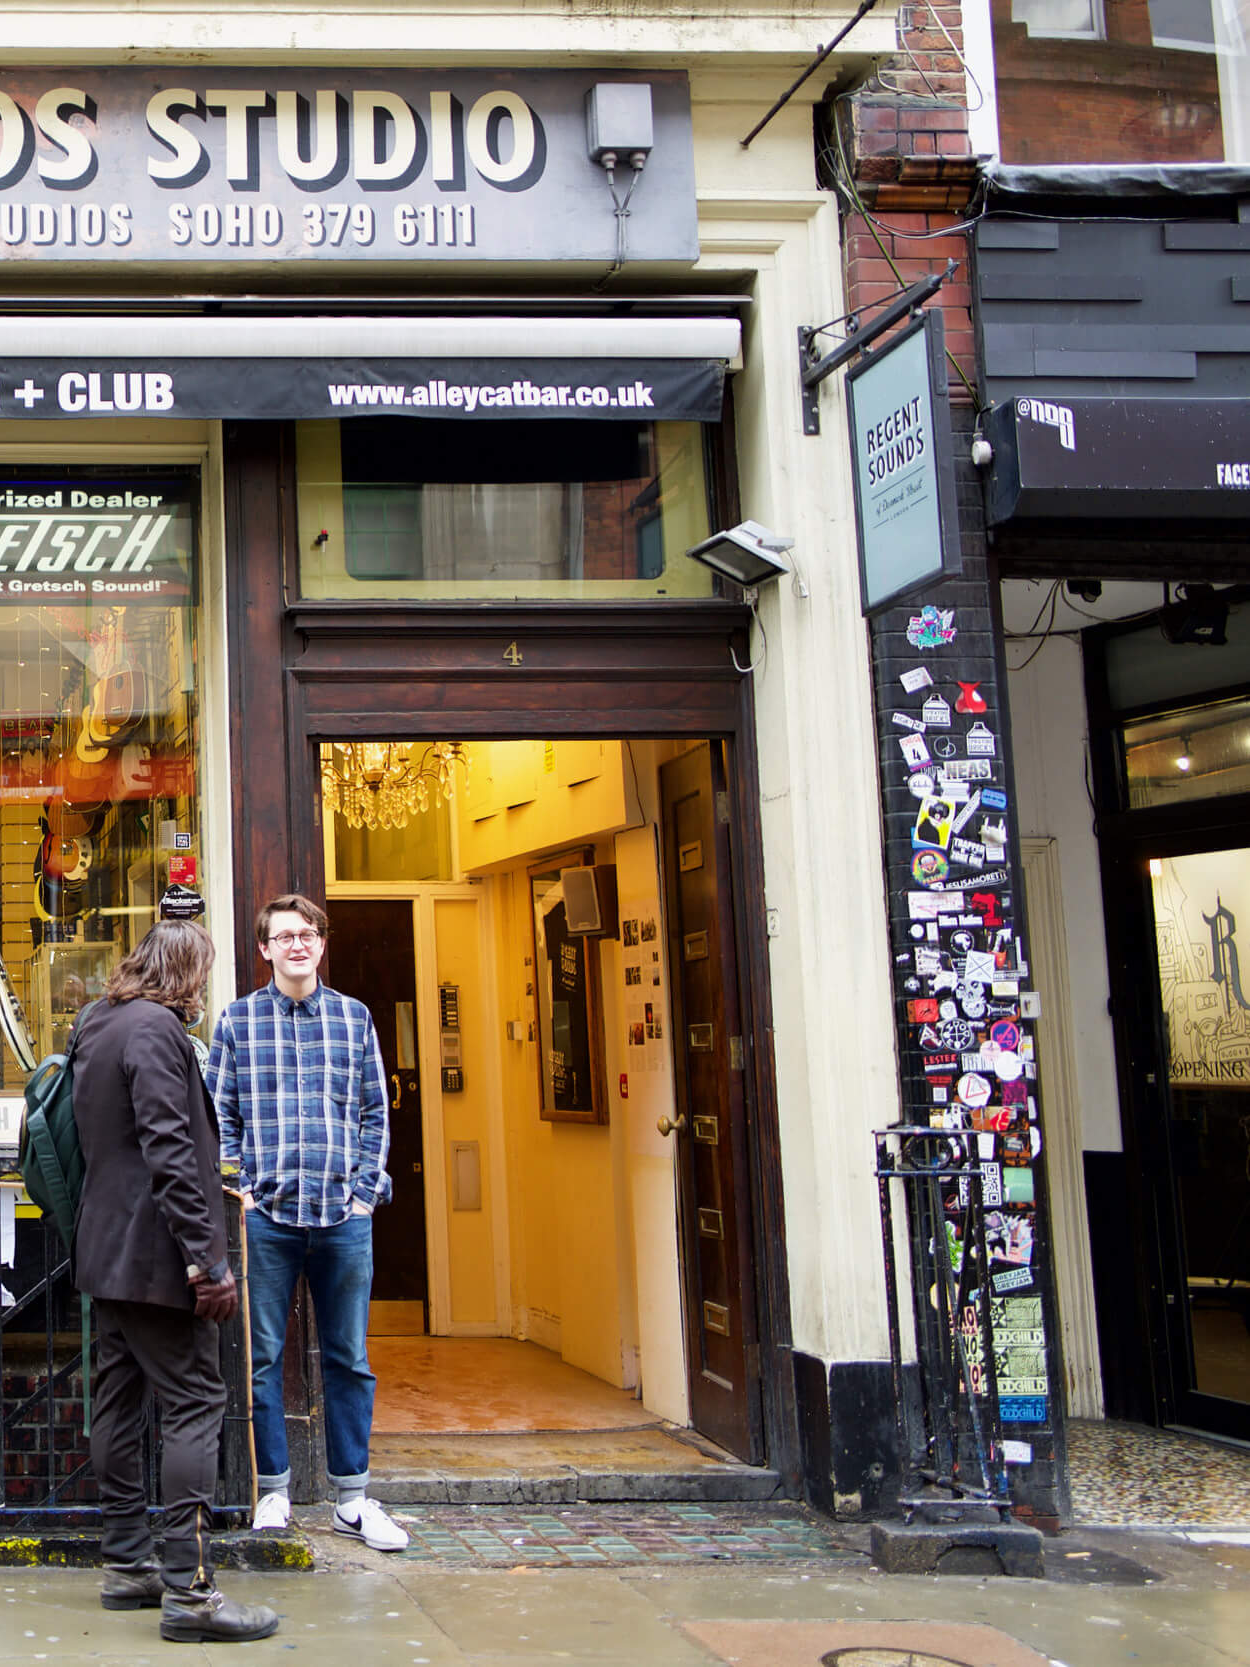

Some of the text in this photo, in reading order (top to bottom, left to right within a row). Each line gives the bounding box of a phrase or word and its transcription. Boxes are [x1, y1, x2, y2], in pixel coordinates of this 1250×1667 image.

[146, 88, 542, 186] STUDIO
[168, 204, 284, 247] SOHO
[302, 204, 375, 247] 379
[394, 204, 476, 248] 6111
[14, 379, 45, 408] +
[58, 372, 175, 412] CLUB
[329, 381, 654, 412] www.alleycatbar.co.uk
[867, 395, 921, 455] REGENT
[868, 427, 926, 487] SOUNDS
[1216, 463, 1250, 486] FACE
[70, 491, 163, 508] Dealer
[8, 580, 85, 592] Gretsch
[502, 641, 523, 666] 4
